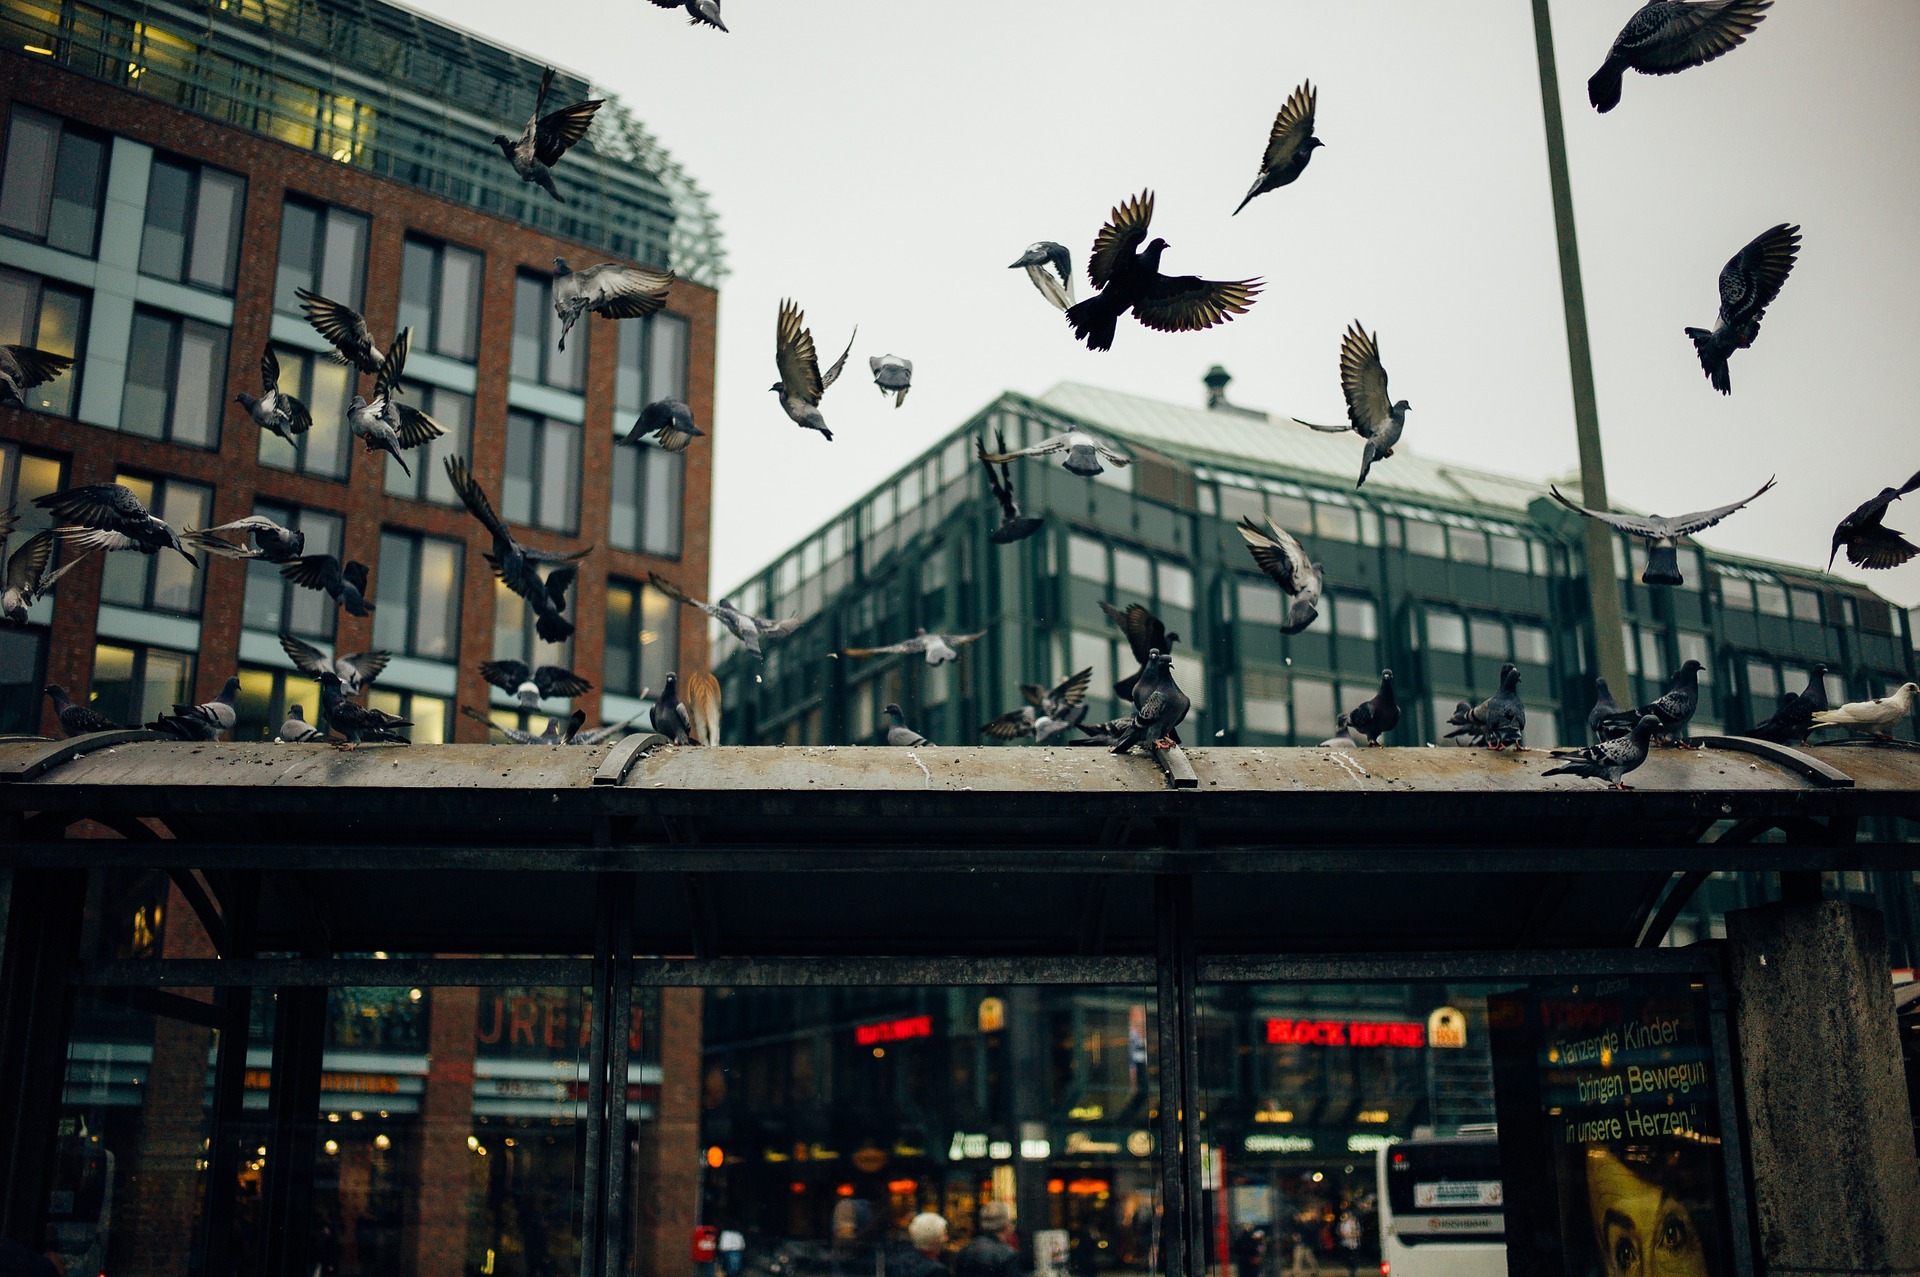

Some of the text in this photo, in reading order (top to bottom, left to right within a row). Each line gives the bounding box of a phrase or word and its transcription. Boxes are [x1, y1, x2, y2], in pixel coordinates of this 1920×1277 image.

[1623, 1017, 1680, 1051] Kinder
[1577, 1072, 1623, 1104] bringen
[1565, 1118, 1575, 1144] in
[1577, 1118, 1623, 1143] unsere
